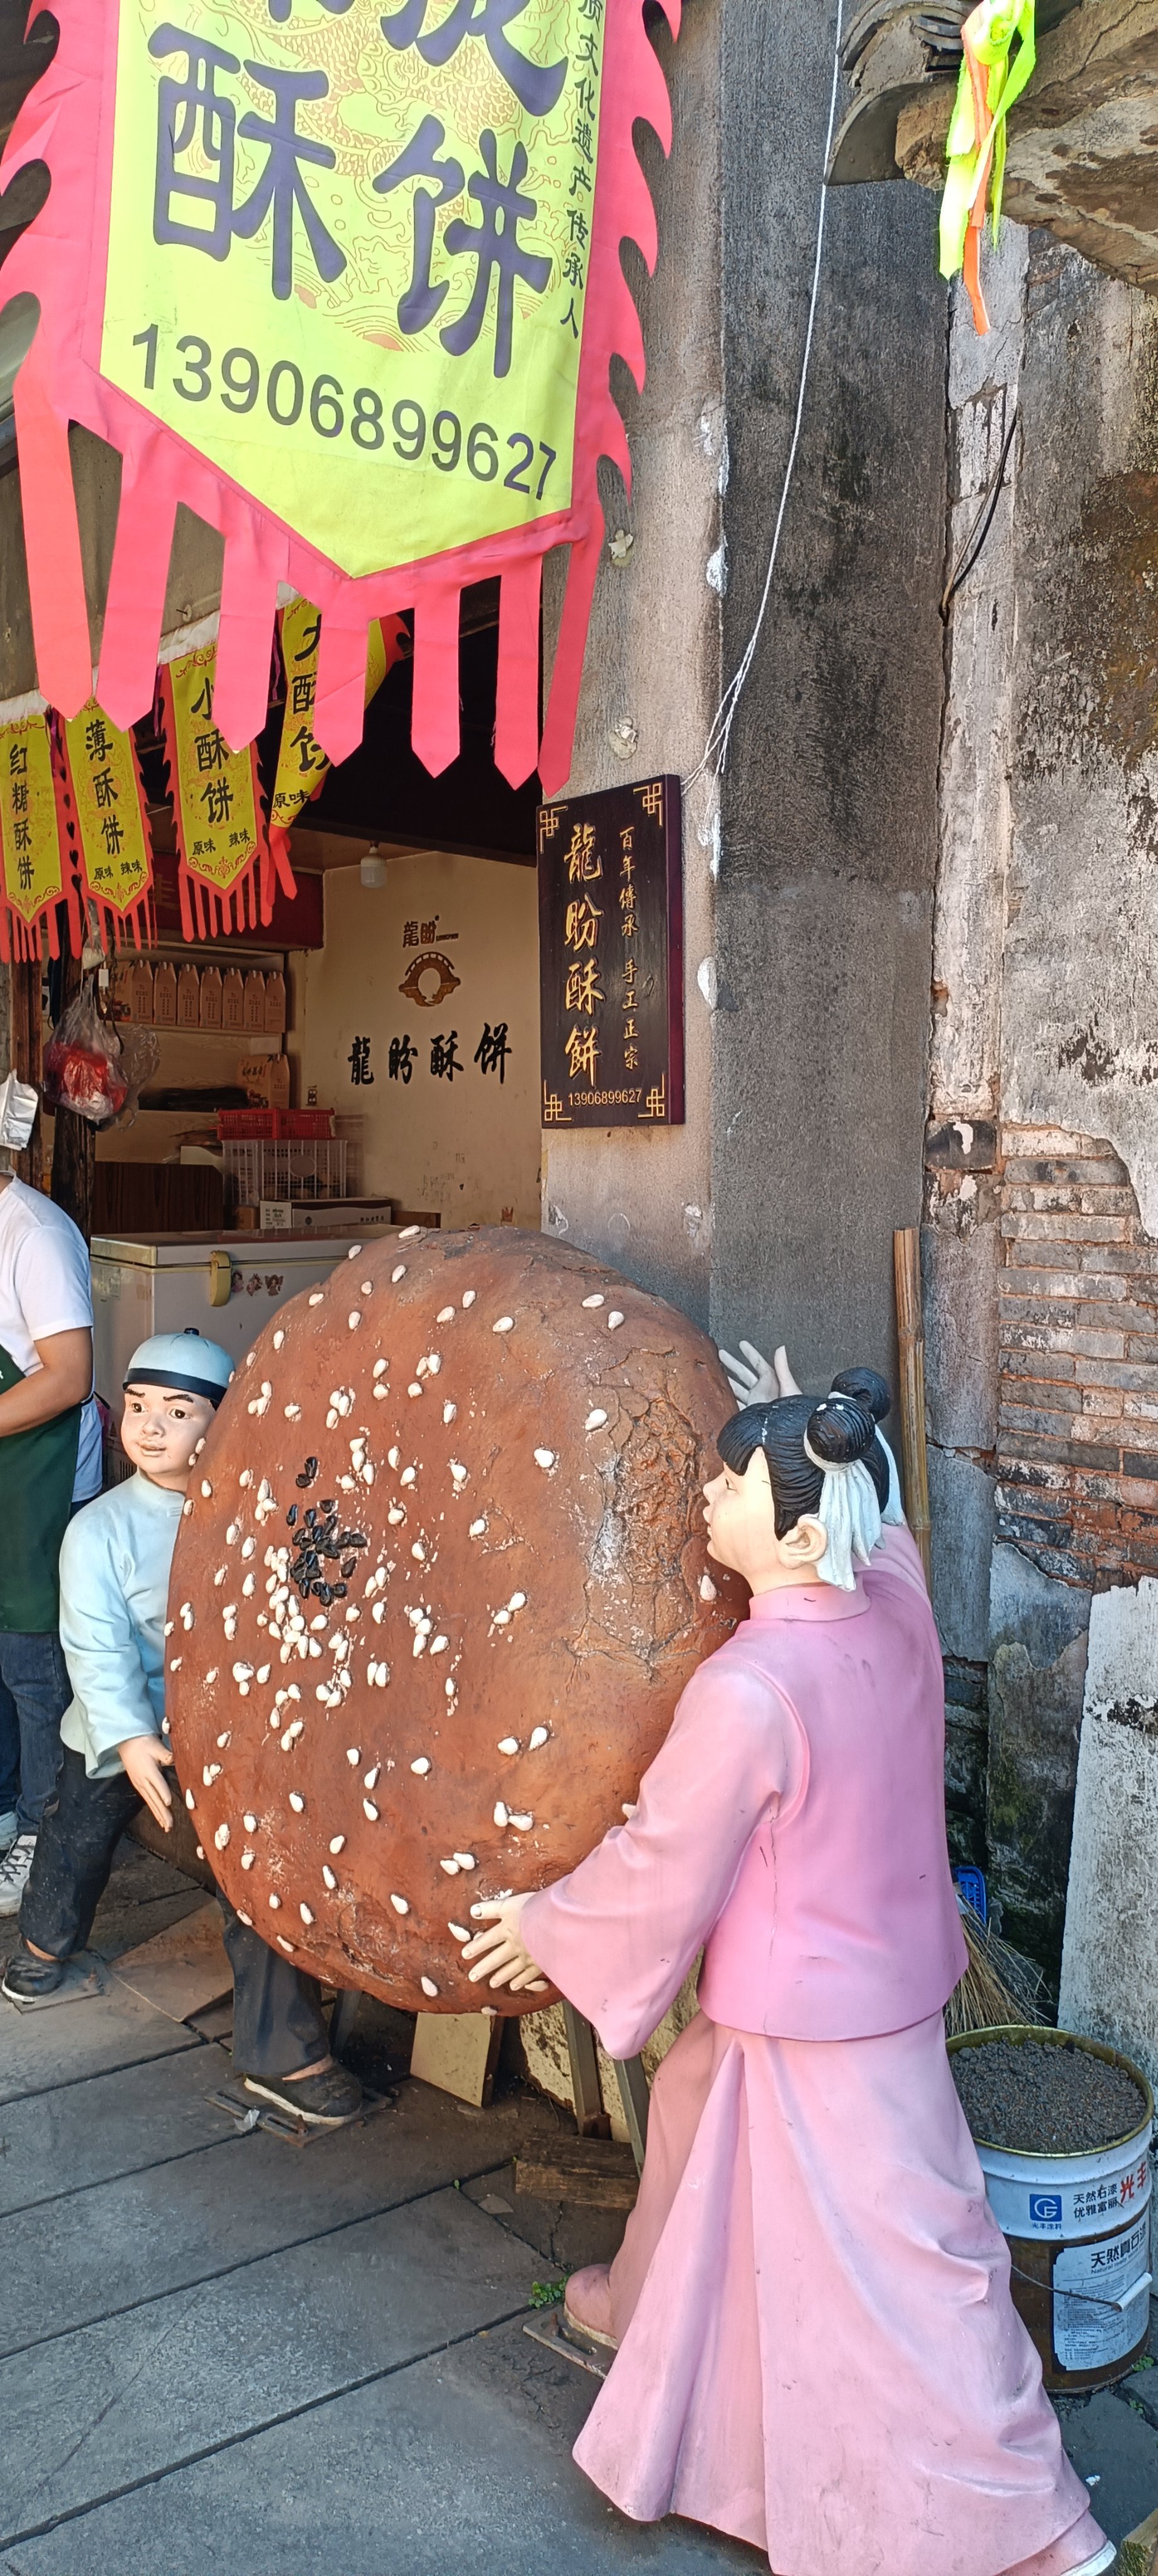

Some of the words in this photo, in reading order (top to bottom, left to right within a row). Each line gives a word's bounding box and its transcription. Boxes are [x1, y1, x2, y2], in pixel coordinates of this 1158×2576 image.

[132, 323, 556, 501] 13906899627
[85, 721, 124, 855] 薄酥饼
[273, 790, 309, 808] 原味
[9, 744, 34, 890] 红糖酥饼
[192, 838, 216, 855] 原味
[228, 828, 250, 846] 辣味
[94, 865, 113, 880] 原味
[121, 859, 142, 875] 辣味
[568, 1089, 642, 1107] 13906899627
[1074, 2197, 1118, 2218] 优雅富丽
[1091, 2263, 1113, 2274] Natural
